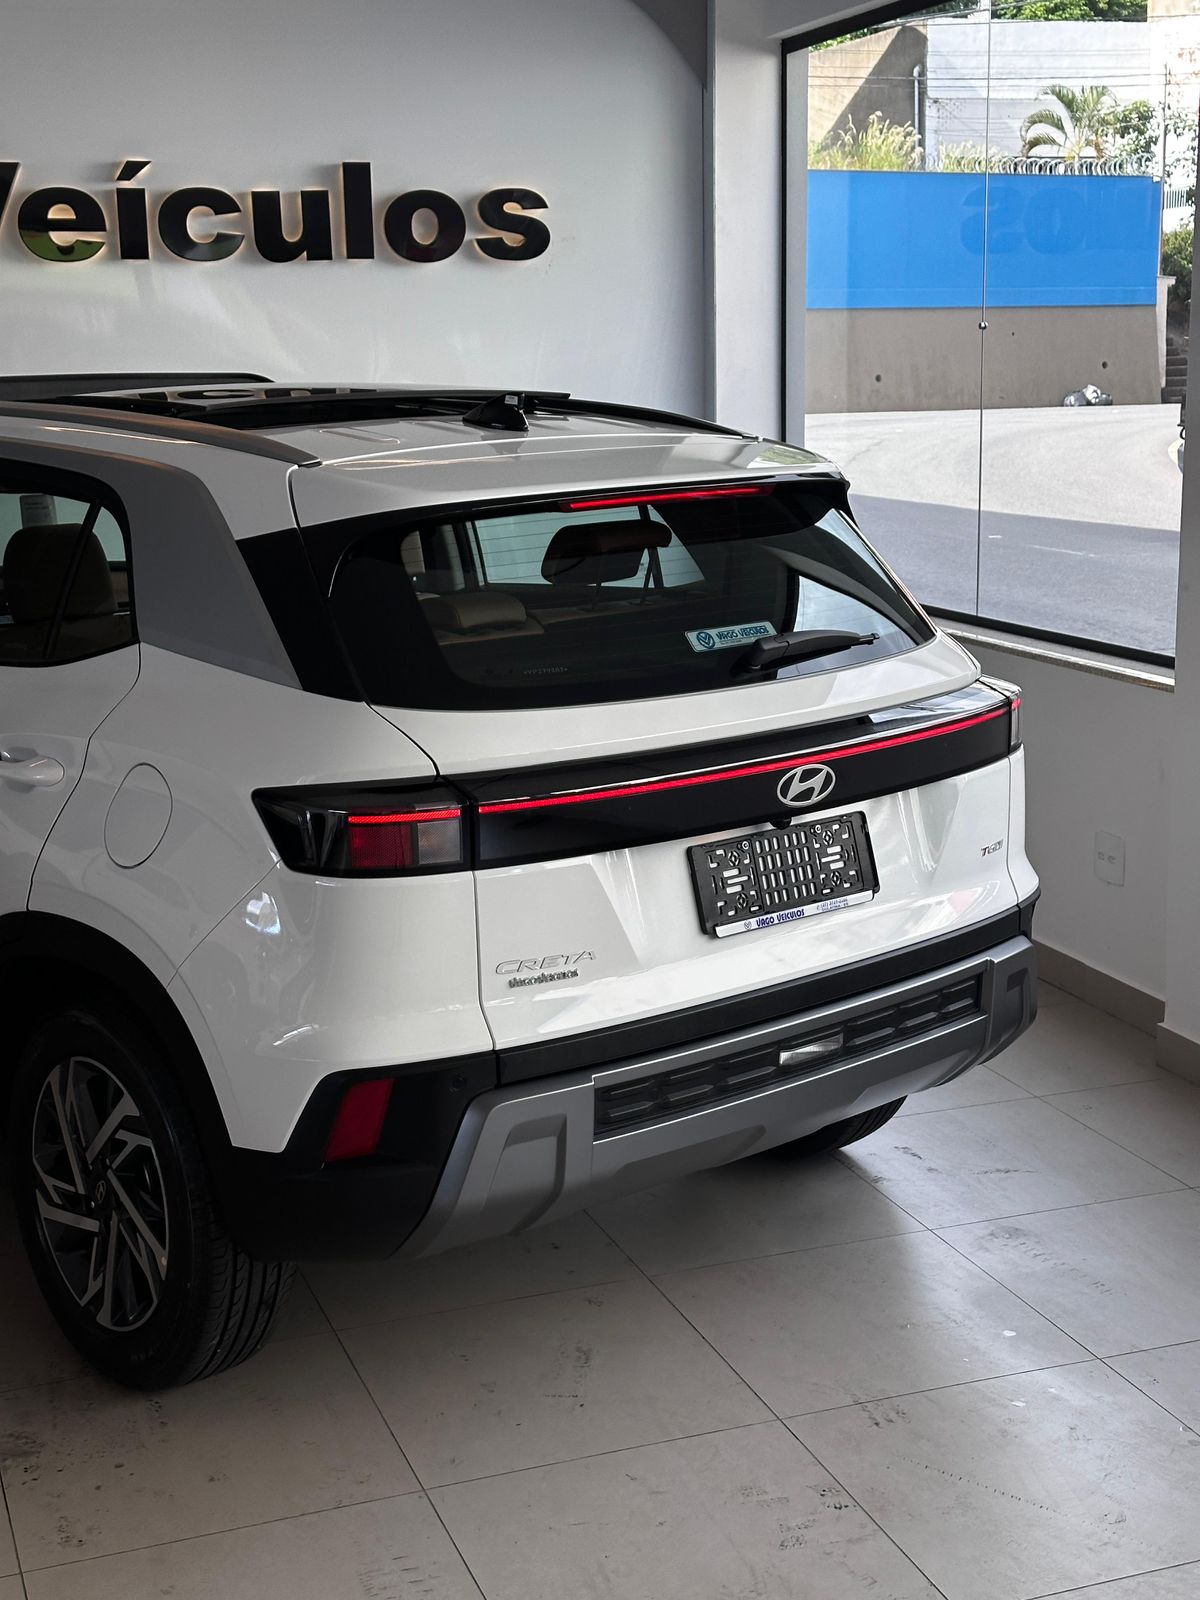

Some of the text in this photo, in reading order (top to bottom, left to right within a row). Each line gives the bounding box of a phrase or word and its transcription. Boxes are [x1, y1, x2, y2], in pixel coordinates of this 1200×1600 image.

[0, 160, 551, 263] eículos
[756, 916, 775, 927] VAGO
[496, 950, 596, 975] CRETA
